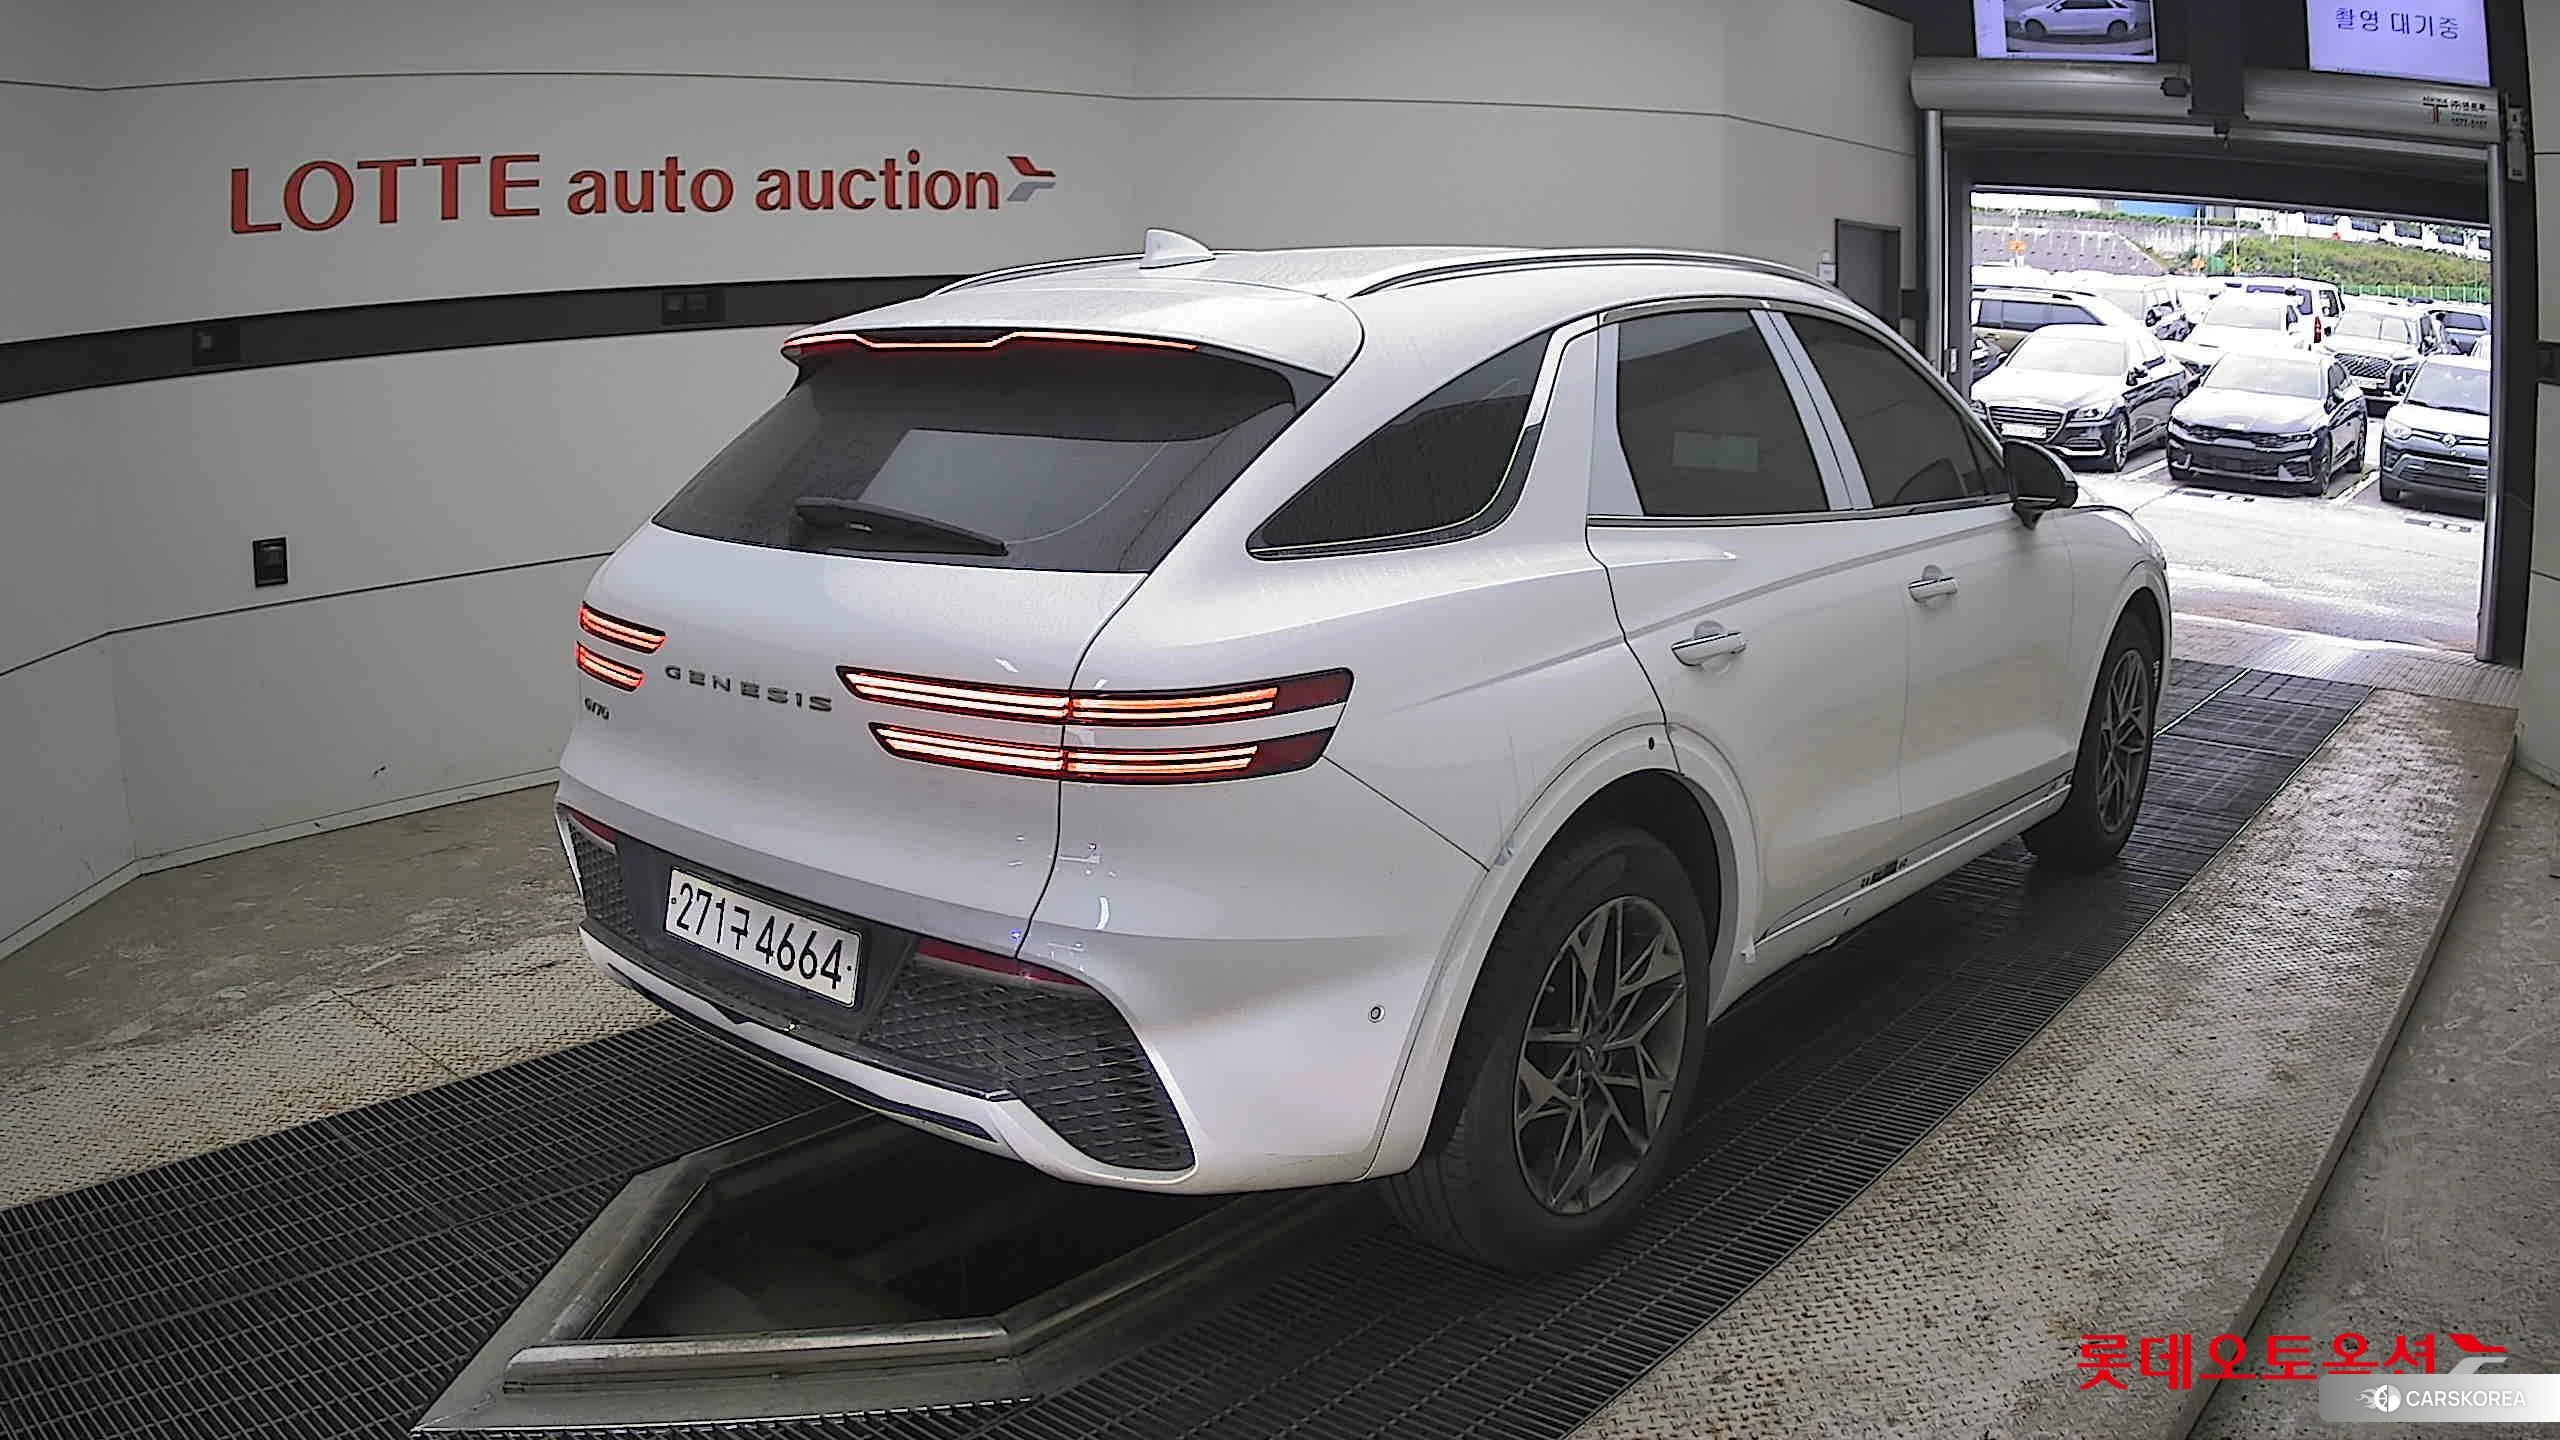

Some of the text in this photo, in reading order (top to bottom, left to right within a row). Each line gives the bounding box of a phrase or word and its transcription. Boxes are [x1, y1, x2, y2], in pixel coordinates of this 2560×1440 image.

[2336, 8, 2459, 40] 촬영 대기중
[230, 149, 1000, 234] LOTTE auto auction
[664, 665, 833, 713] GENESIS
